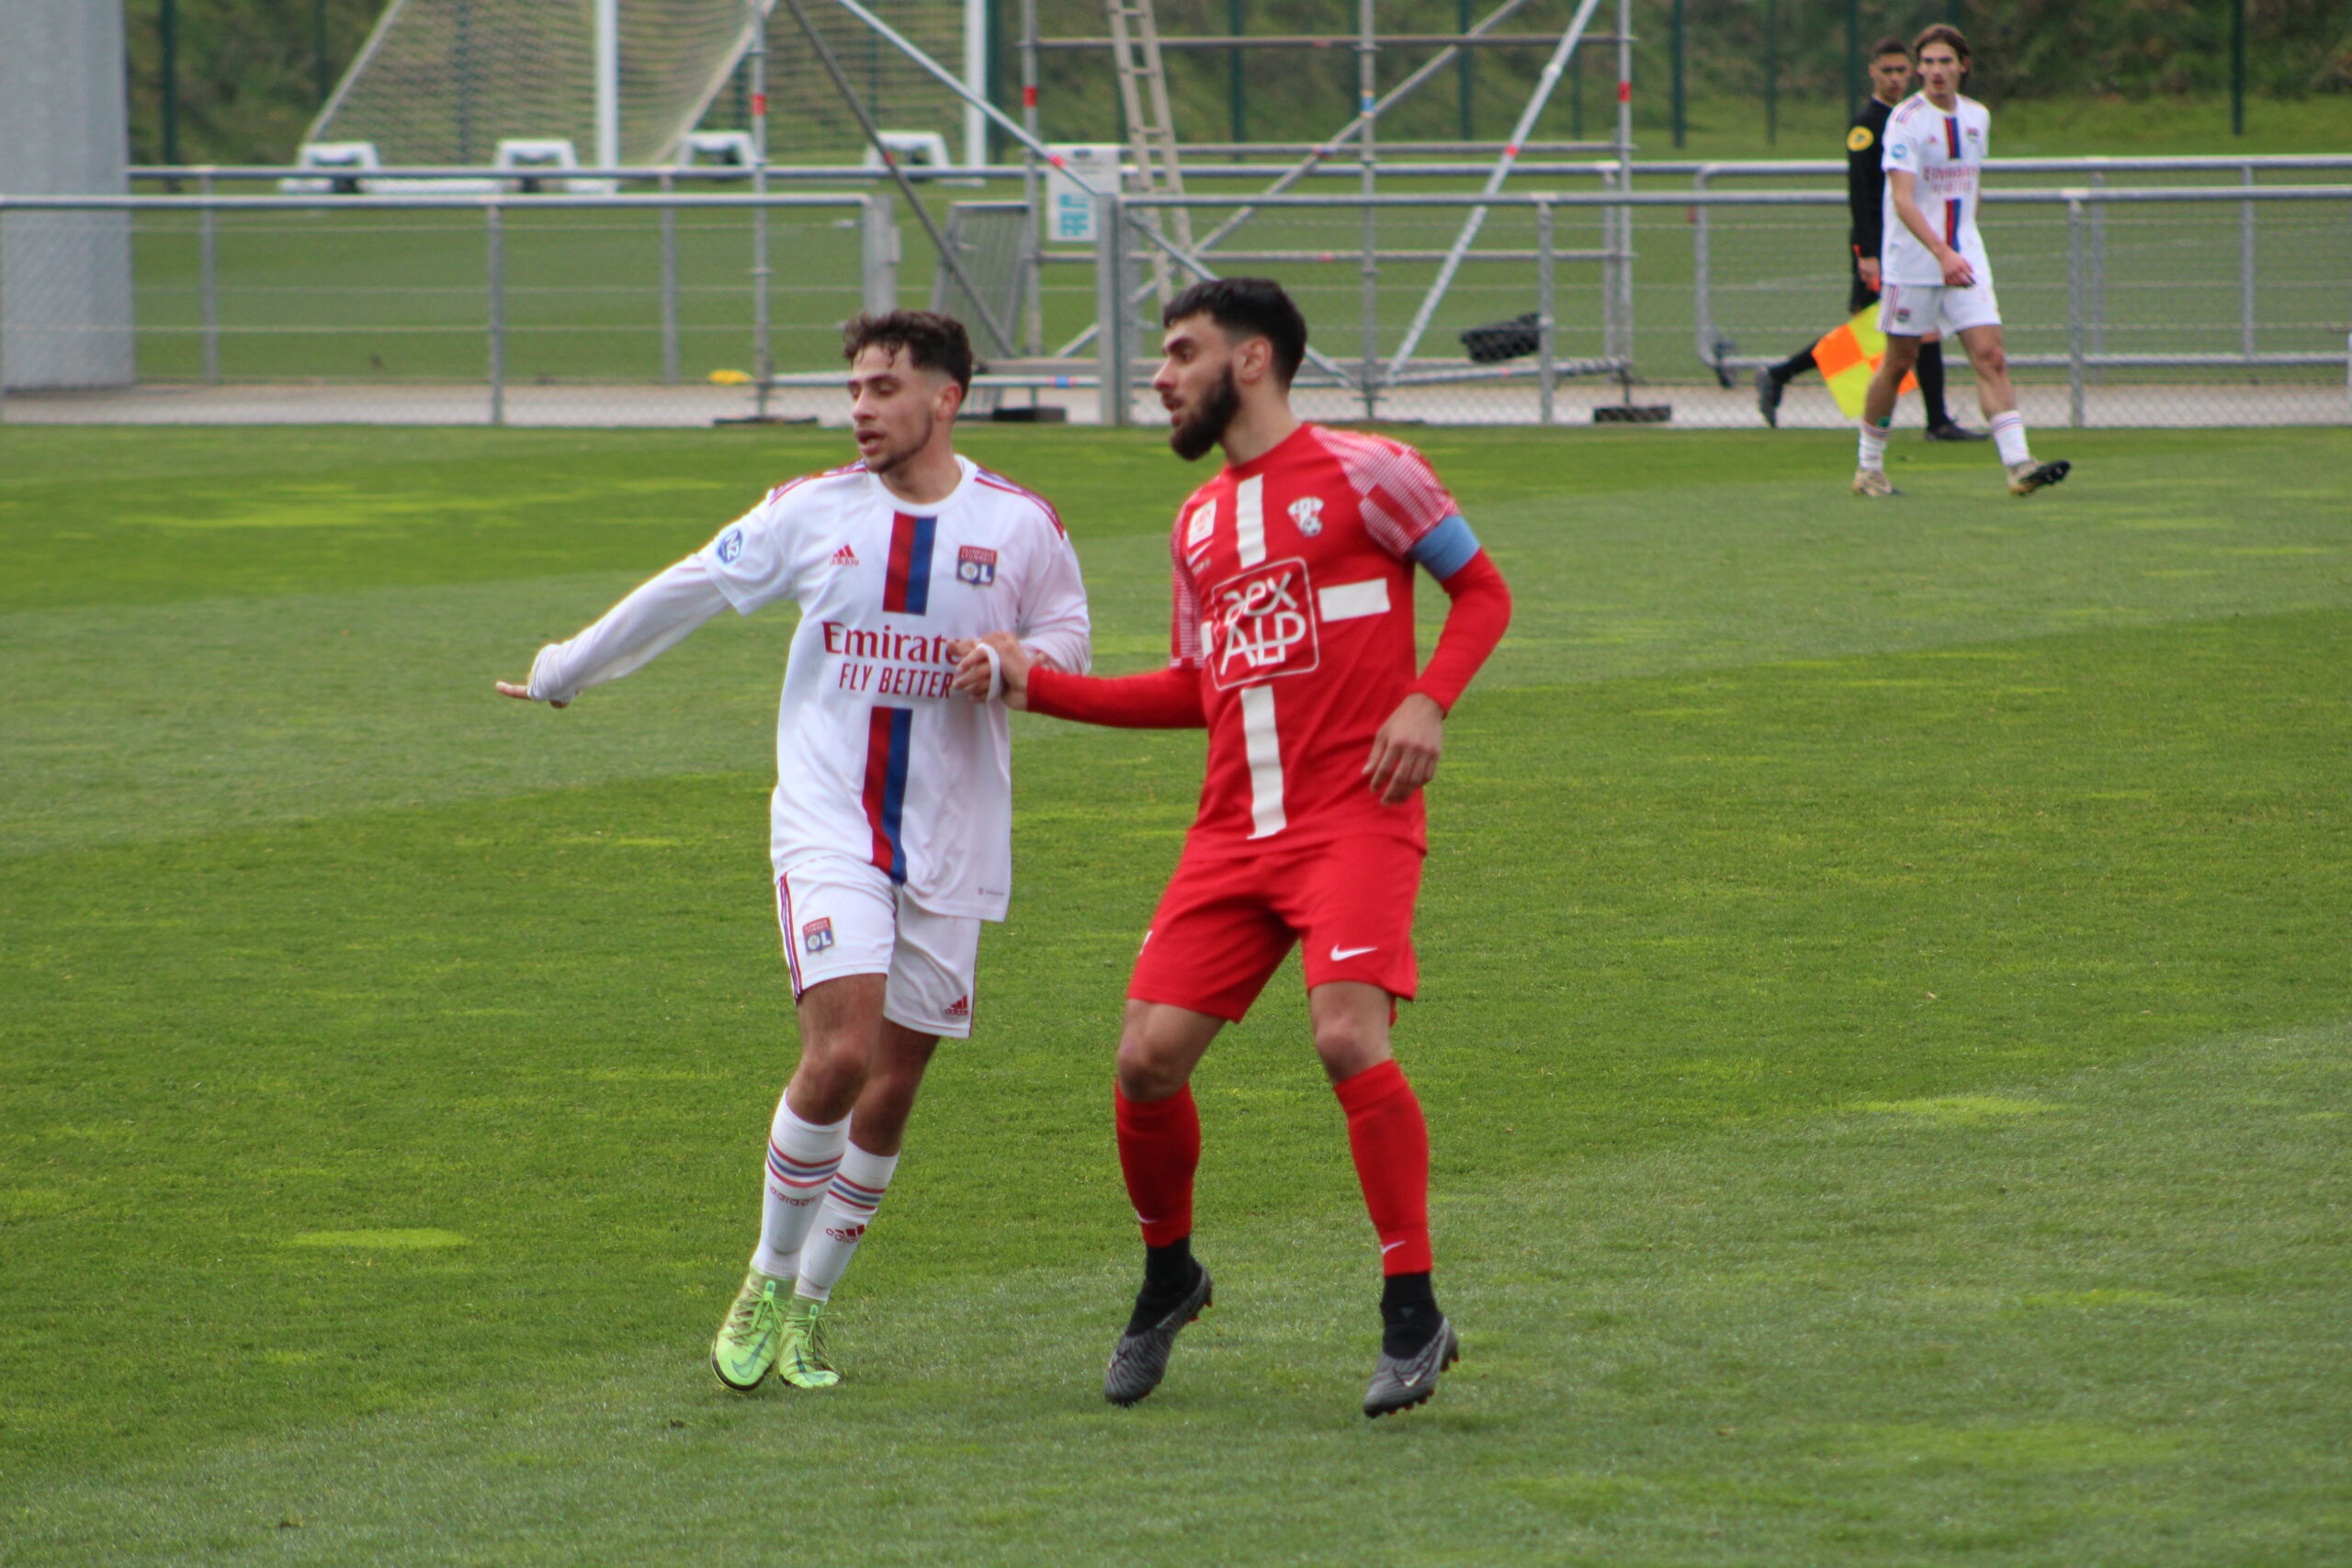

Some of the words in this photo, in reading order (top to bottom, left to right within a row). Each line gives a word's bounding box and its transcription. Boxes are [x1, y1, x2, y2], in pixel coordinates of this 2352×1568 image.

[830, 558, 860, 567] adidas
[1219, 611, 1306, 676] ALP
[839, 662, 873, 691] FLY
[878, 666, 955, 698] BETTER
[770, 1186, 816, 1206] adidas
